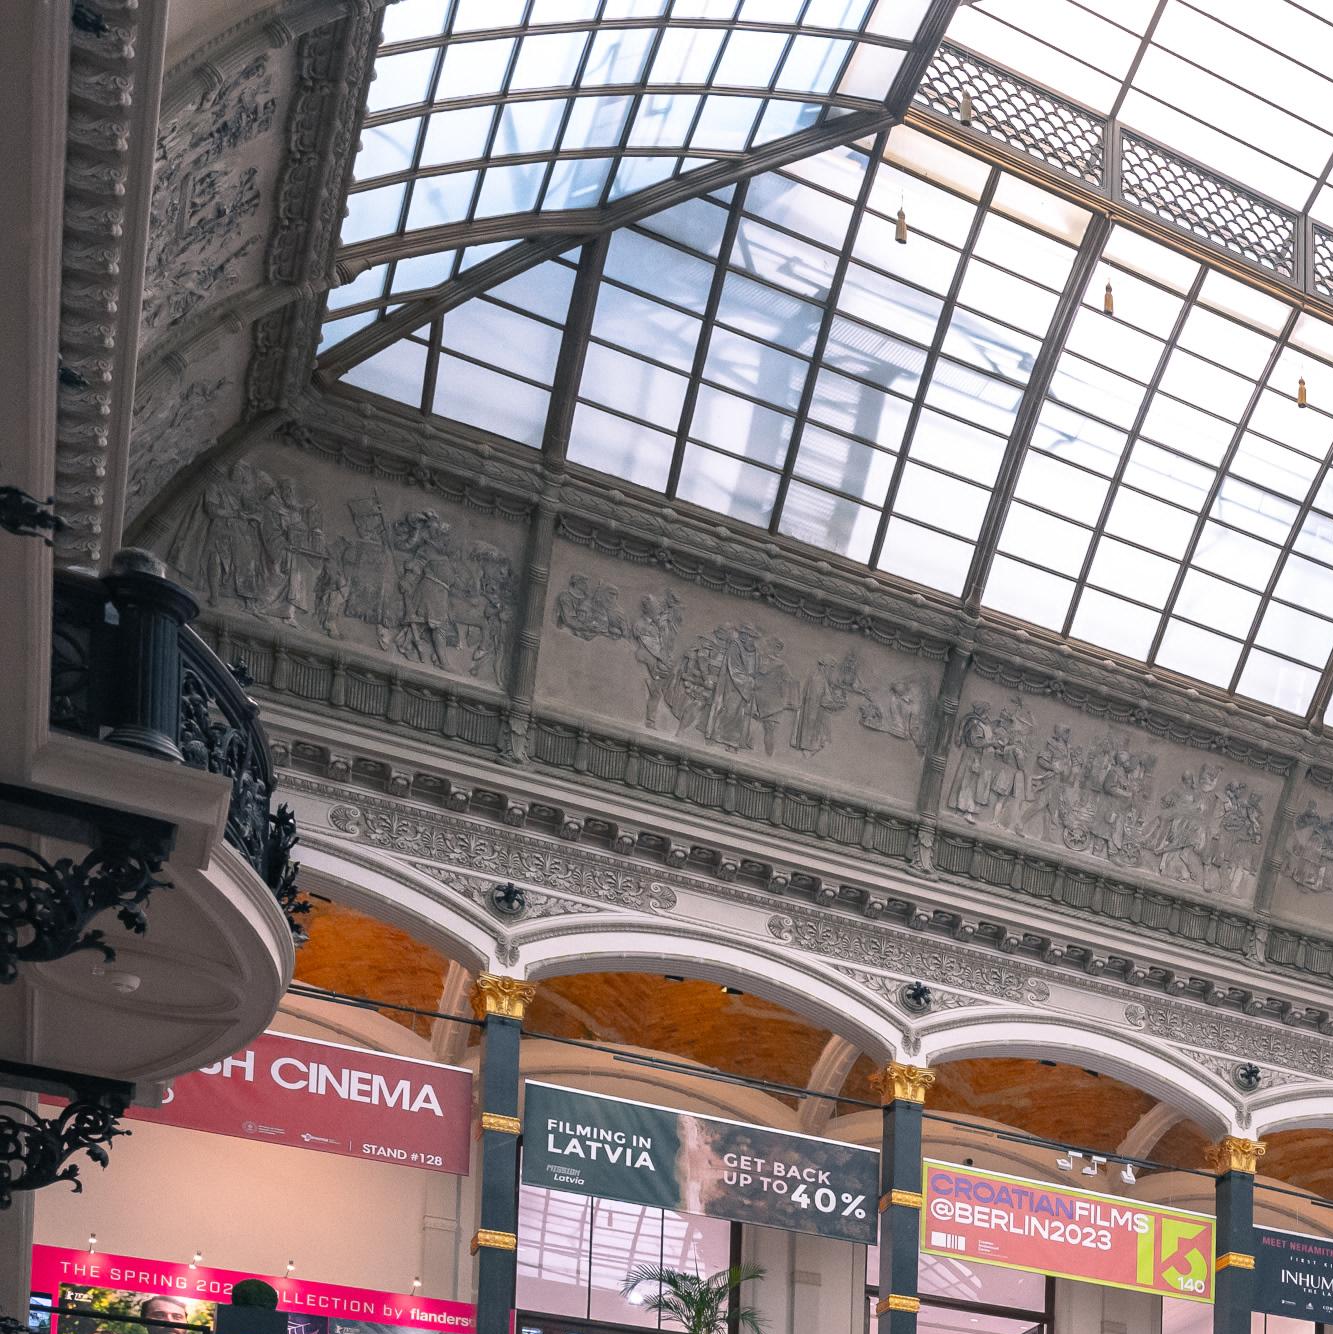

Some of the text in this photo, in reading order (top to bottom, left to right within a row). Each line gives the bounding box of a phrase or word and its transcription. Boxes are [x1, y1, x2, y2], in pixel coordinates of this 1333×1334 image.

[270, 1057, 444, 1117] CINEMA
[547, 1119, 652, 1150] FILMING IN
[362, 1143, 443, 1167] STAND #128
[547, 1133, 656, 1172] LATVIA
[553, 1173, 585, 1185] Latvia
[723, 1152, 832, 1186] GET BACK
[723, 1171, 867, 1220] UP TO 40%
[930, 1198, 1111, 1250] @BERLIN2023
[1262, 1236, 1286, 1249] MEET
[1290, 1256, 1317, 1265] FIRST
[60, 1261, 234, 1295] THE SPRING 202
[1177, 1276, 1205, 1294] 140
[1303, 1287, 1318, 1295] THE
[383, 1305, 403, 1320] by
